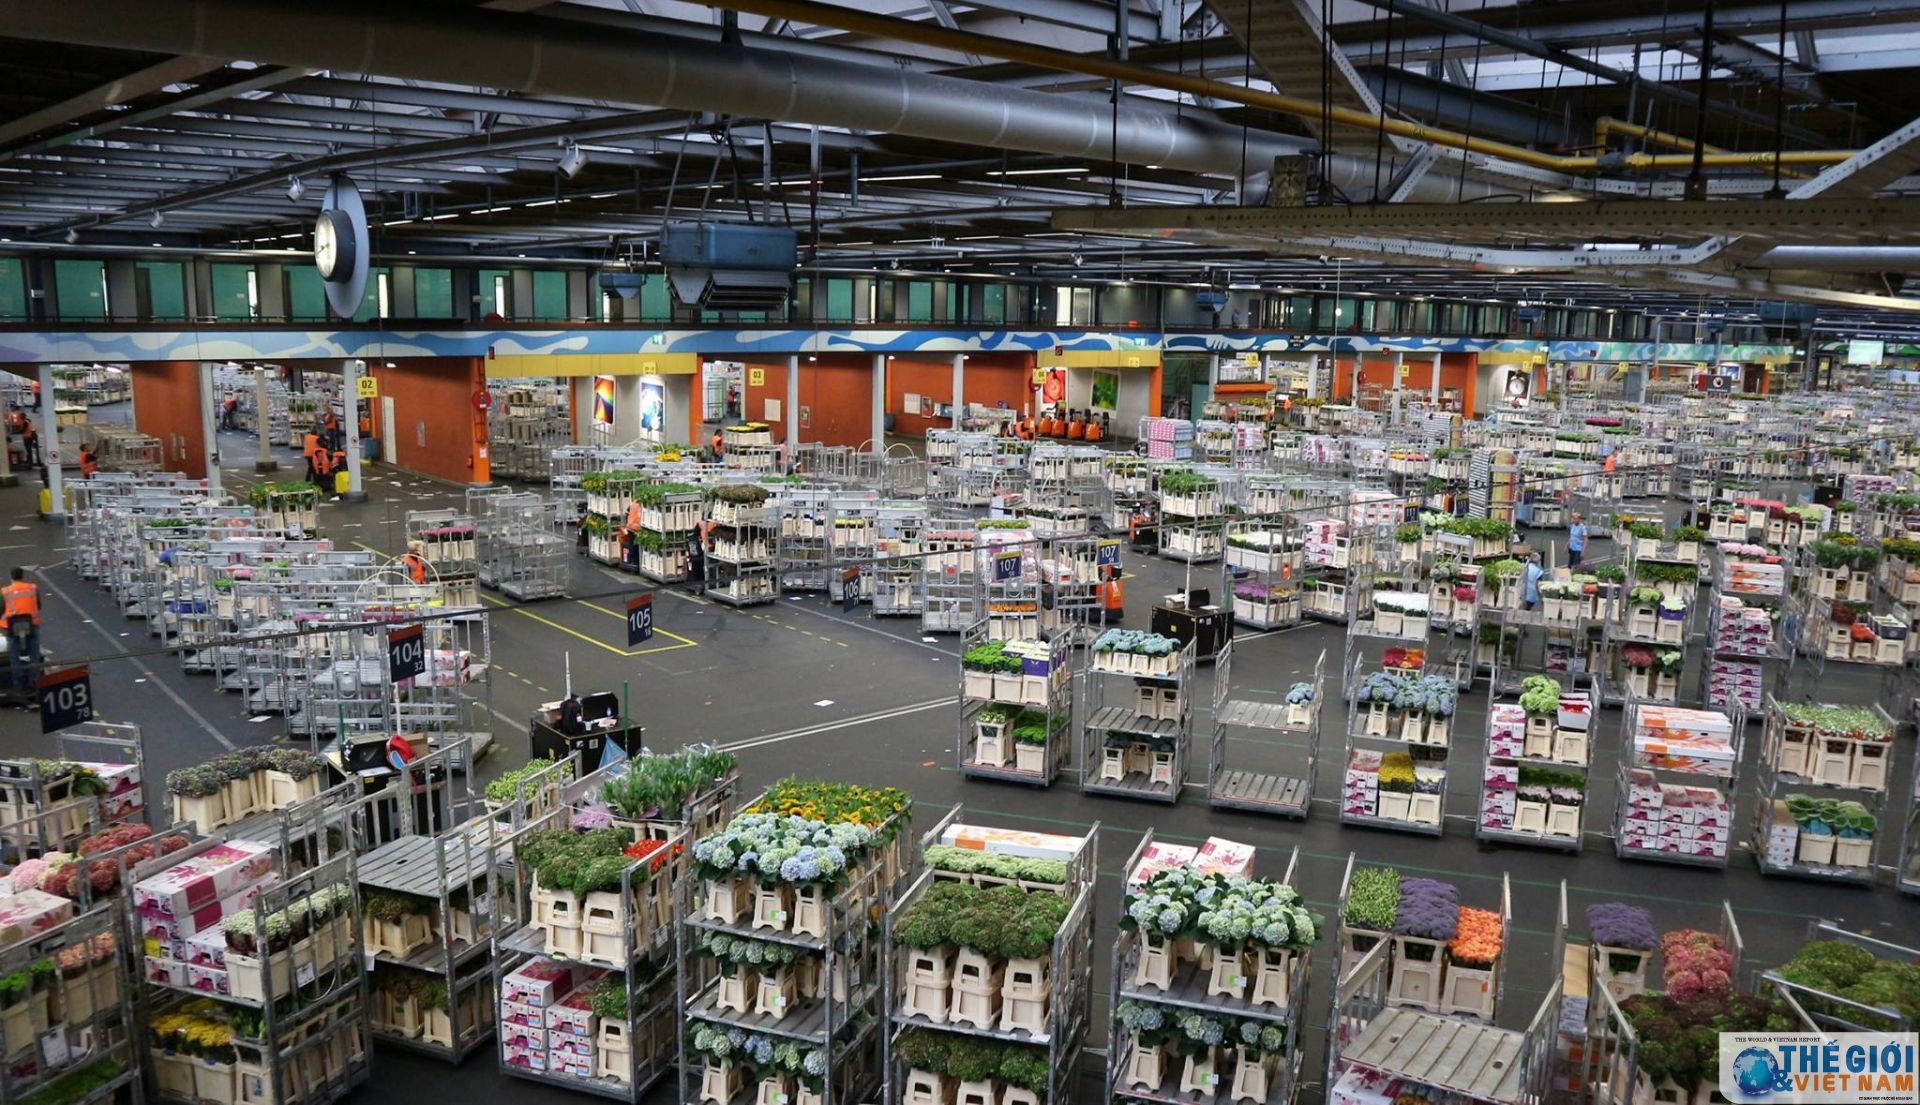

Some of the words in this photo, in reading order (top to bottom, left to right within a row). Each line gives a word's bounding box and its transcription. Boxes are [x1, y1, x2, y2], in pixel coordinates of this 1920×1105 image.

[361, 380, 373, 389] 02
[1100, 545, 1117, 559] 107
[1000, 558, 1017, 573] 107
[844, 578, 859, 601] 106
[629, 607, 651, 631] 105
[391, 639, 423, 666] 104
[414, 660, 424, 672] 32
[43, 683, 88, 714] 103
[76, 706, 90, 720] 78
